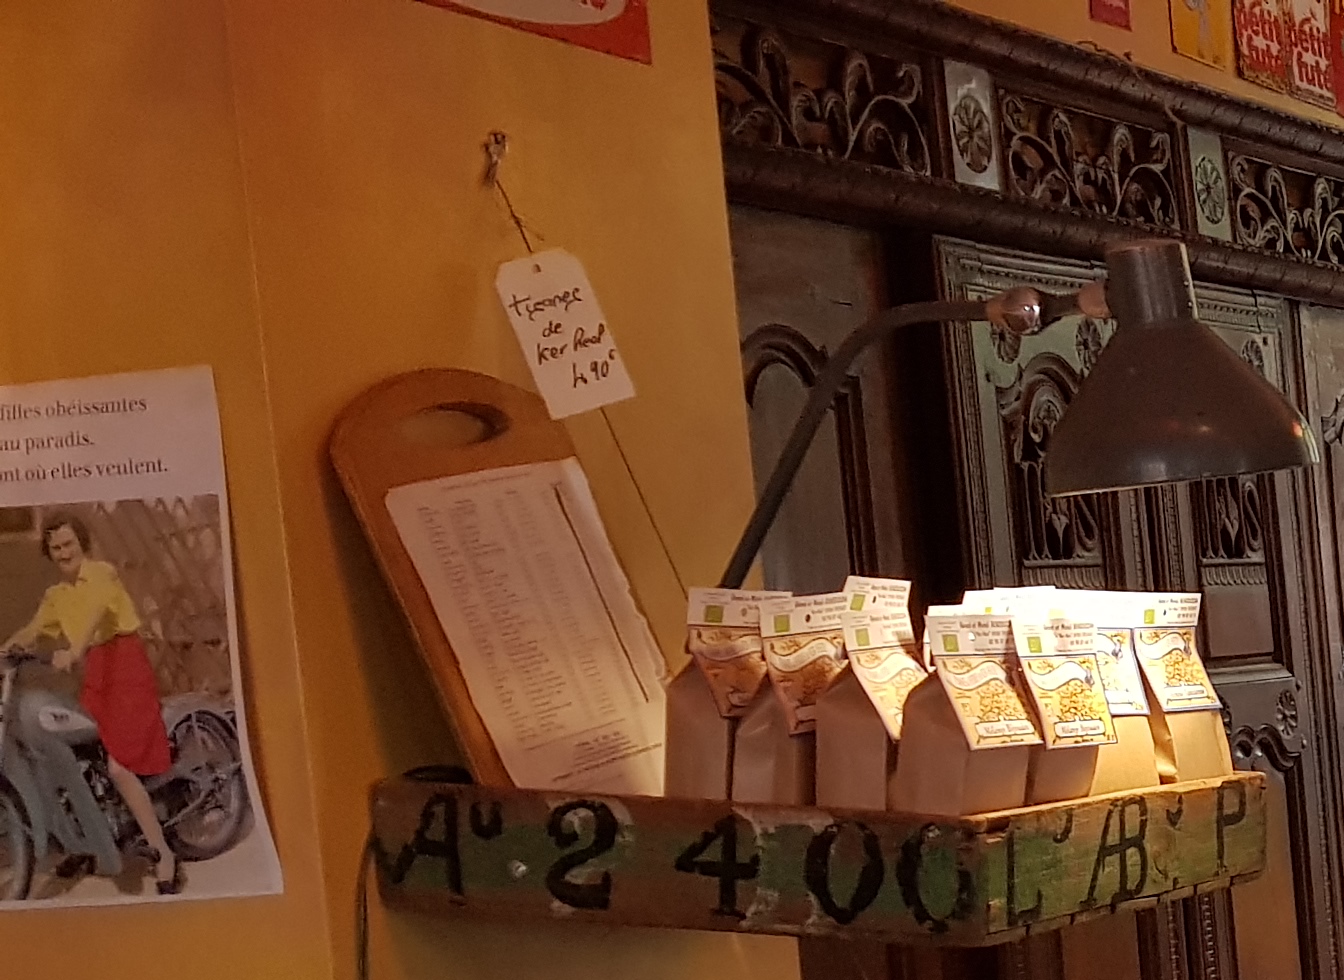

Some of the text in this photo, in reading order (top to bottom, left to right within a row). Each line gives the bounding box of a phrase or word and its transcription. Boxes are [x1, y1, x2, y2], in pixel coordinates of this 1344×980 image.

[542, 320, 562, 338] de
[46, 398, 147, 416] obéissantes
[24, 430, 95, 455] paradis.
[25, 464, 46, 482] où
[51, 461, 92, 479] elles
[95, 456, 168, 476] veulent.
